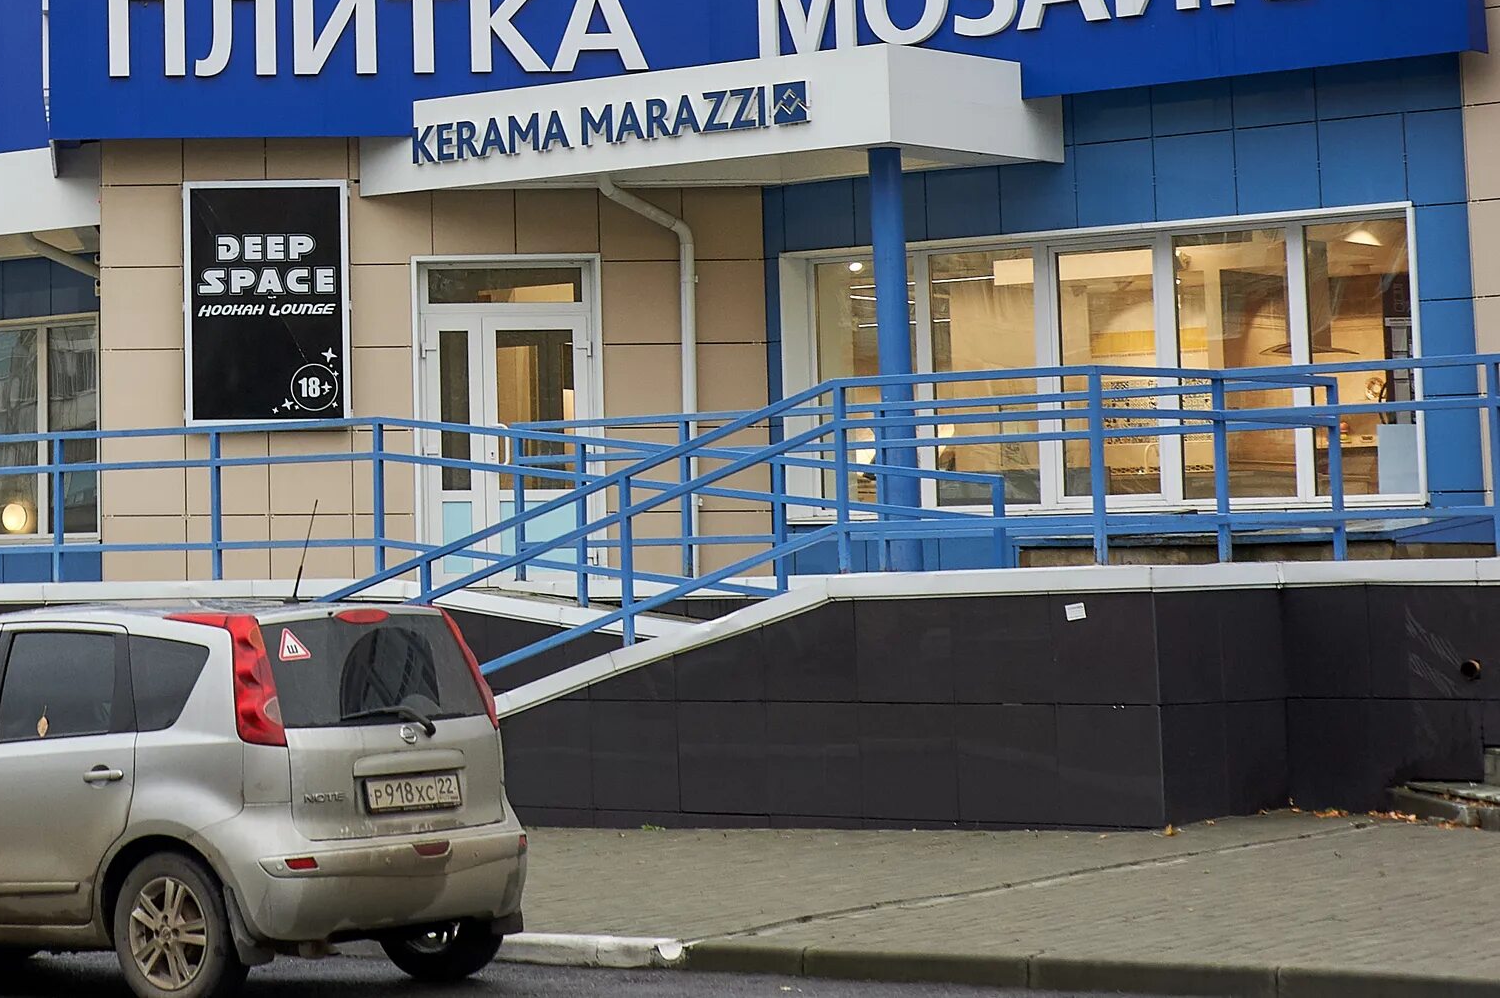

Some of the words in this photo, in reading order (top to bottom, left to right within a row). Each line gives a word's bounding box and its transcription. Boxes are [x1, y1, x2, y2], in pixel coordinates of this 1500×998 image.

[412, 110, 574, 165] KERAMA
[580, 86, 769, 146] MARAZZI
[216, 234, 316, 262] DEEP
[198, 267, 336, 295] SPACE
[198, 304, 265, 317] HOOKAH
[268, 303, 336, 316] LOUNGE
[437, 778, 453, 794] 22
